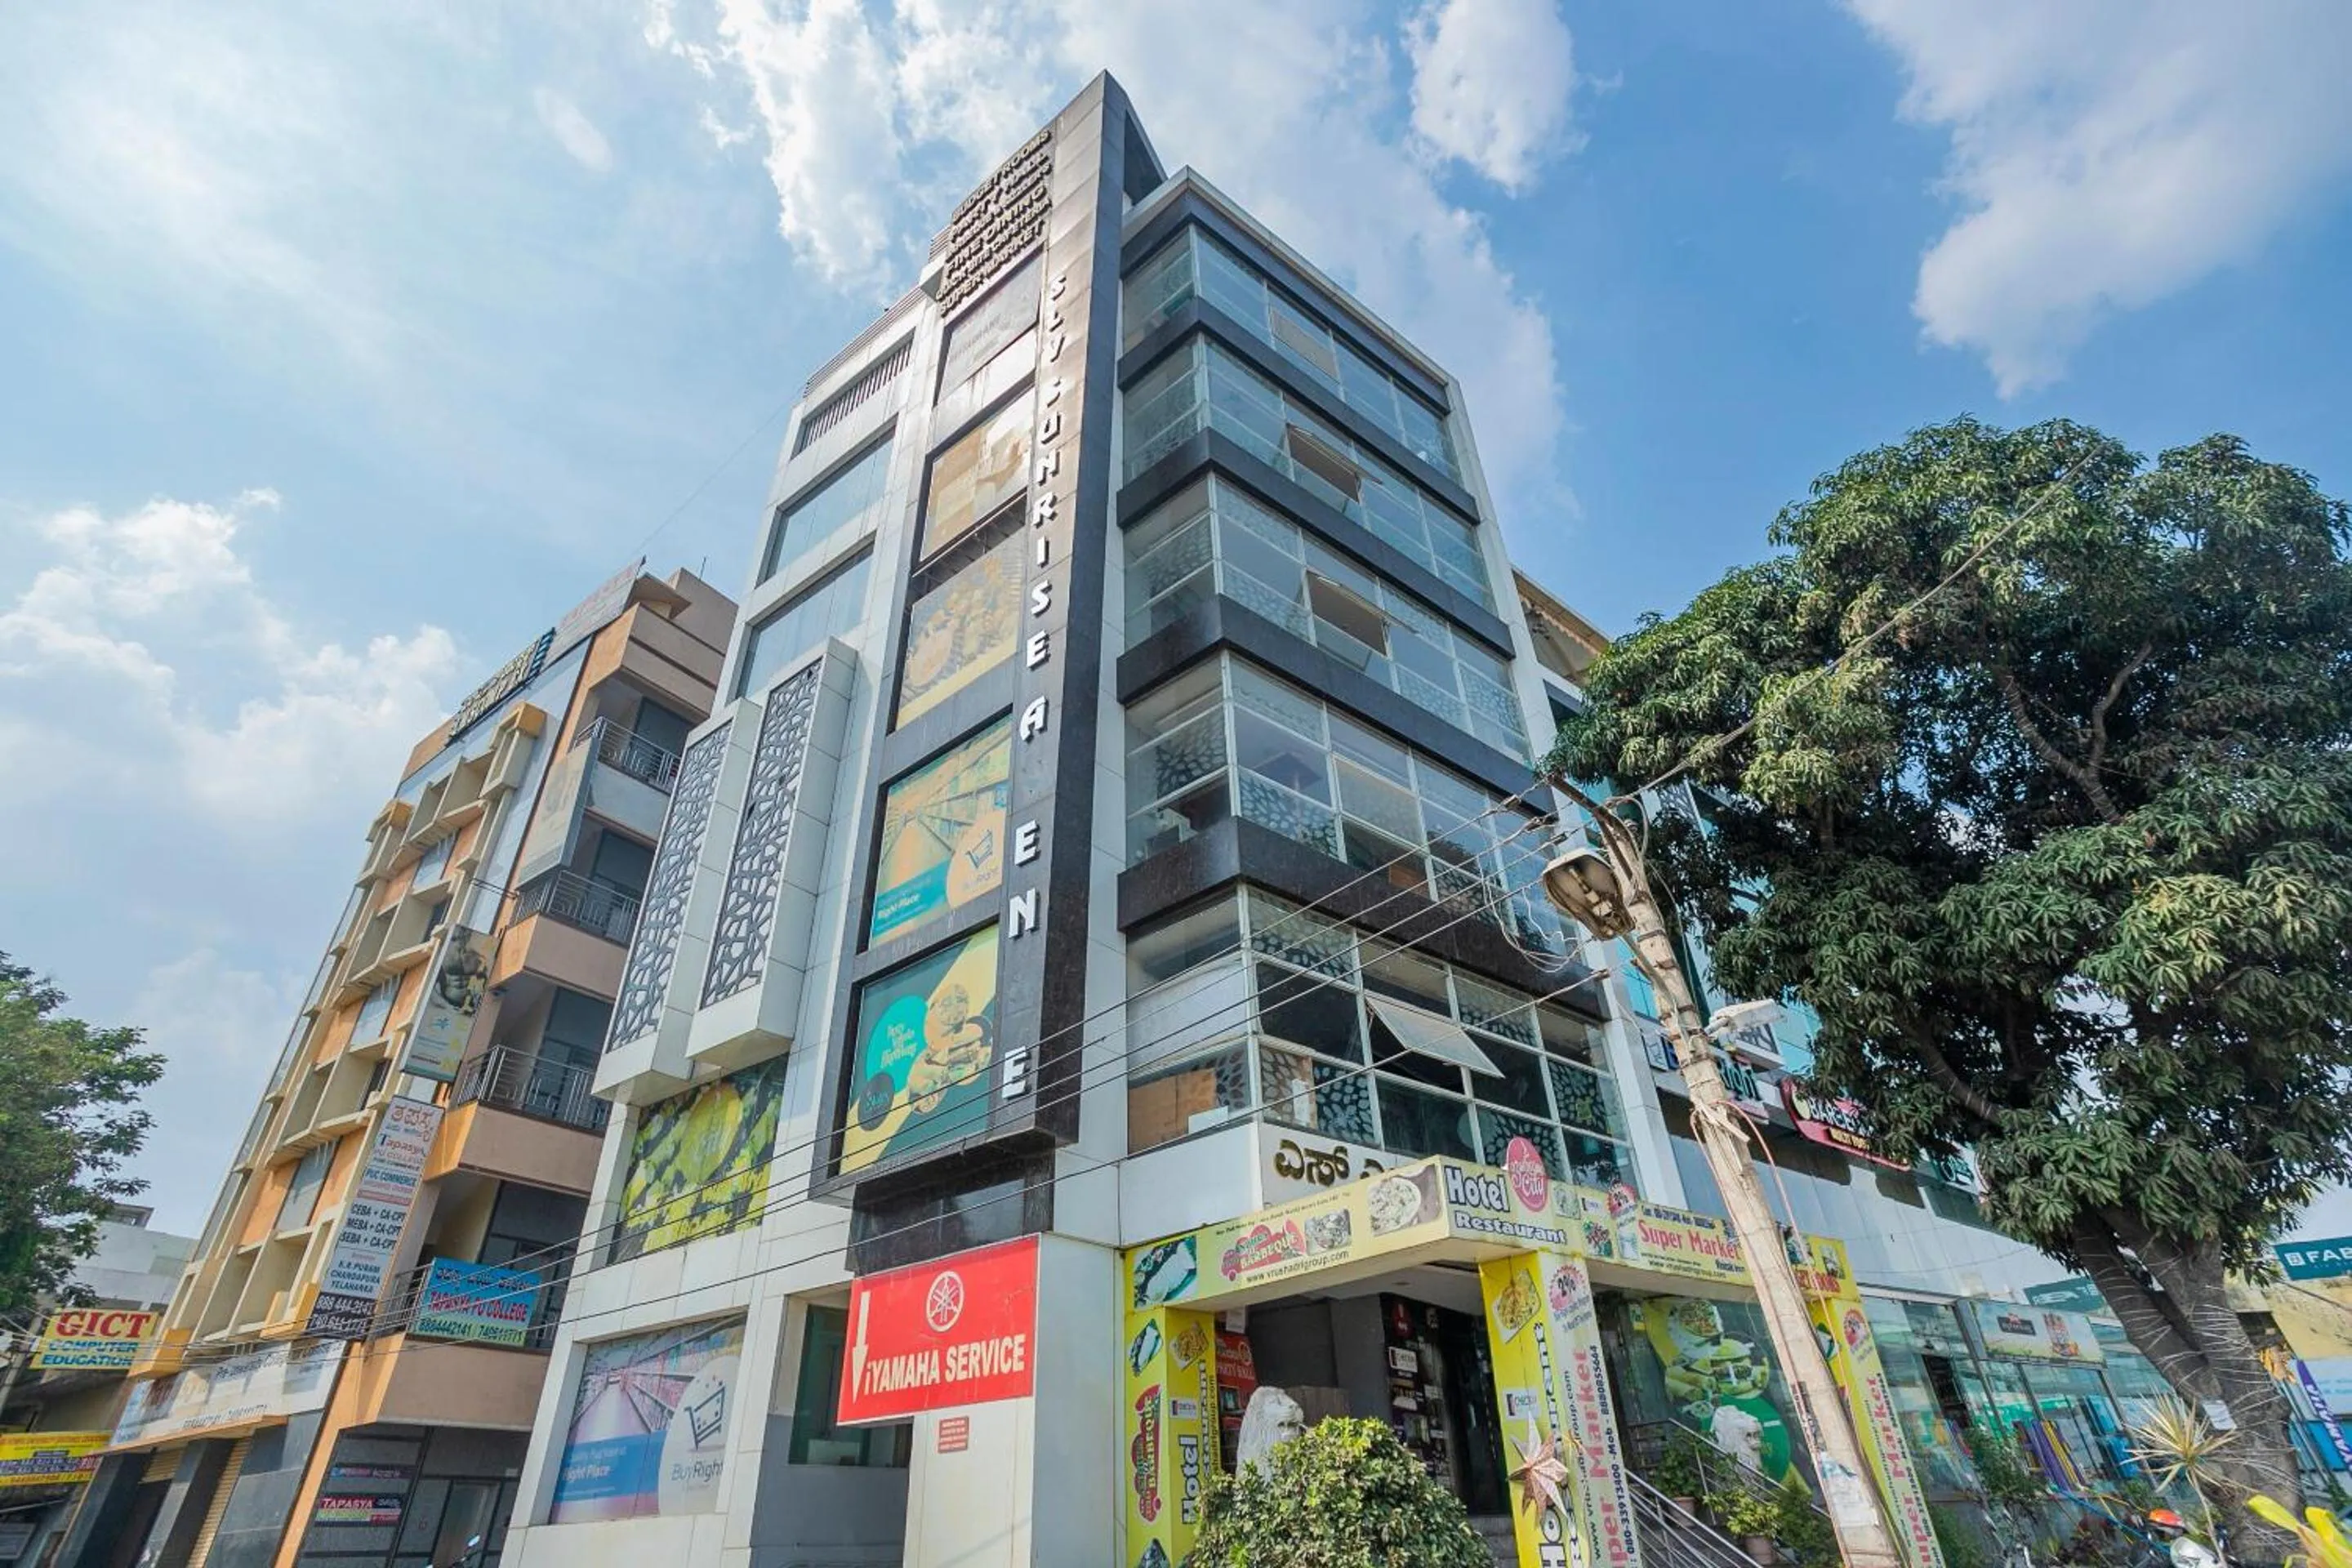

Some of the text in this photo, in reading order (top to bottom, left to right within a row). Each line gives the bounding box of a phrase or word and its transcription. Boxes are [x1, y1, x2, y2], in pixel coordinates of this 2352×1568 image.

[947, 237, 984, 280] FINE
[987, 185, 1048, 244] DINING
[941, 272, 983, 318] SUPER
[986, 219, 1045, 278] MARKET
[1444, 1165, 1511, 1214] Hotel
[1454, 1209, 1569, 1246] Restaurant
[1638, 1218, 1683, 1251] Super
[1688, 1228, 1743, 1262] Market
[56, 1311, 152, 1339] GICT
[486, 1298, 528, 1322] COLLEGE
[42, 1354, 133, 1366] EDUCATION
[48, 1339, 140, 1354] COMPUTER
[944, 1333, 1027, 1383] SERVICE
[1572, 1348, 1609, 1479] Market
[1865, 1376, 1907, 1480] Market
[1178, 1435, 1200, 1525] Hotel
[322, 1497, 374, 1510] TAPASYA
